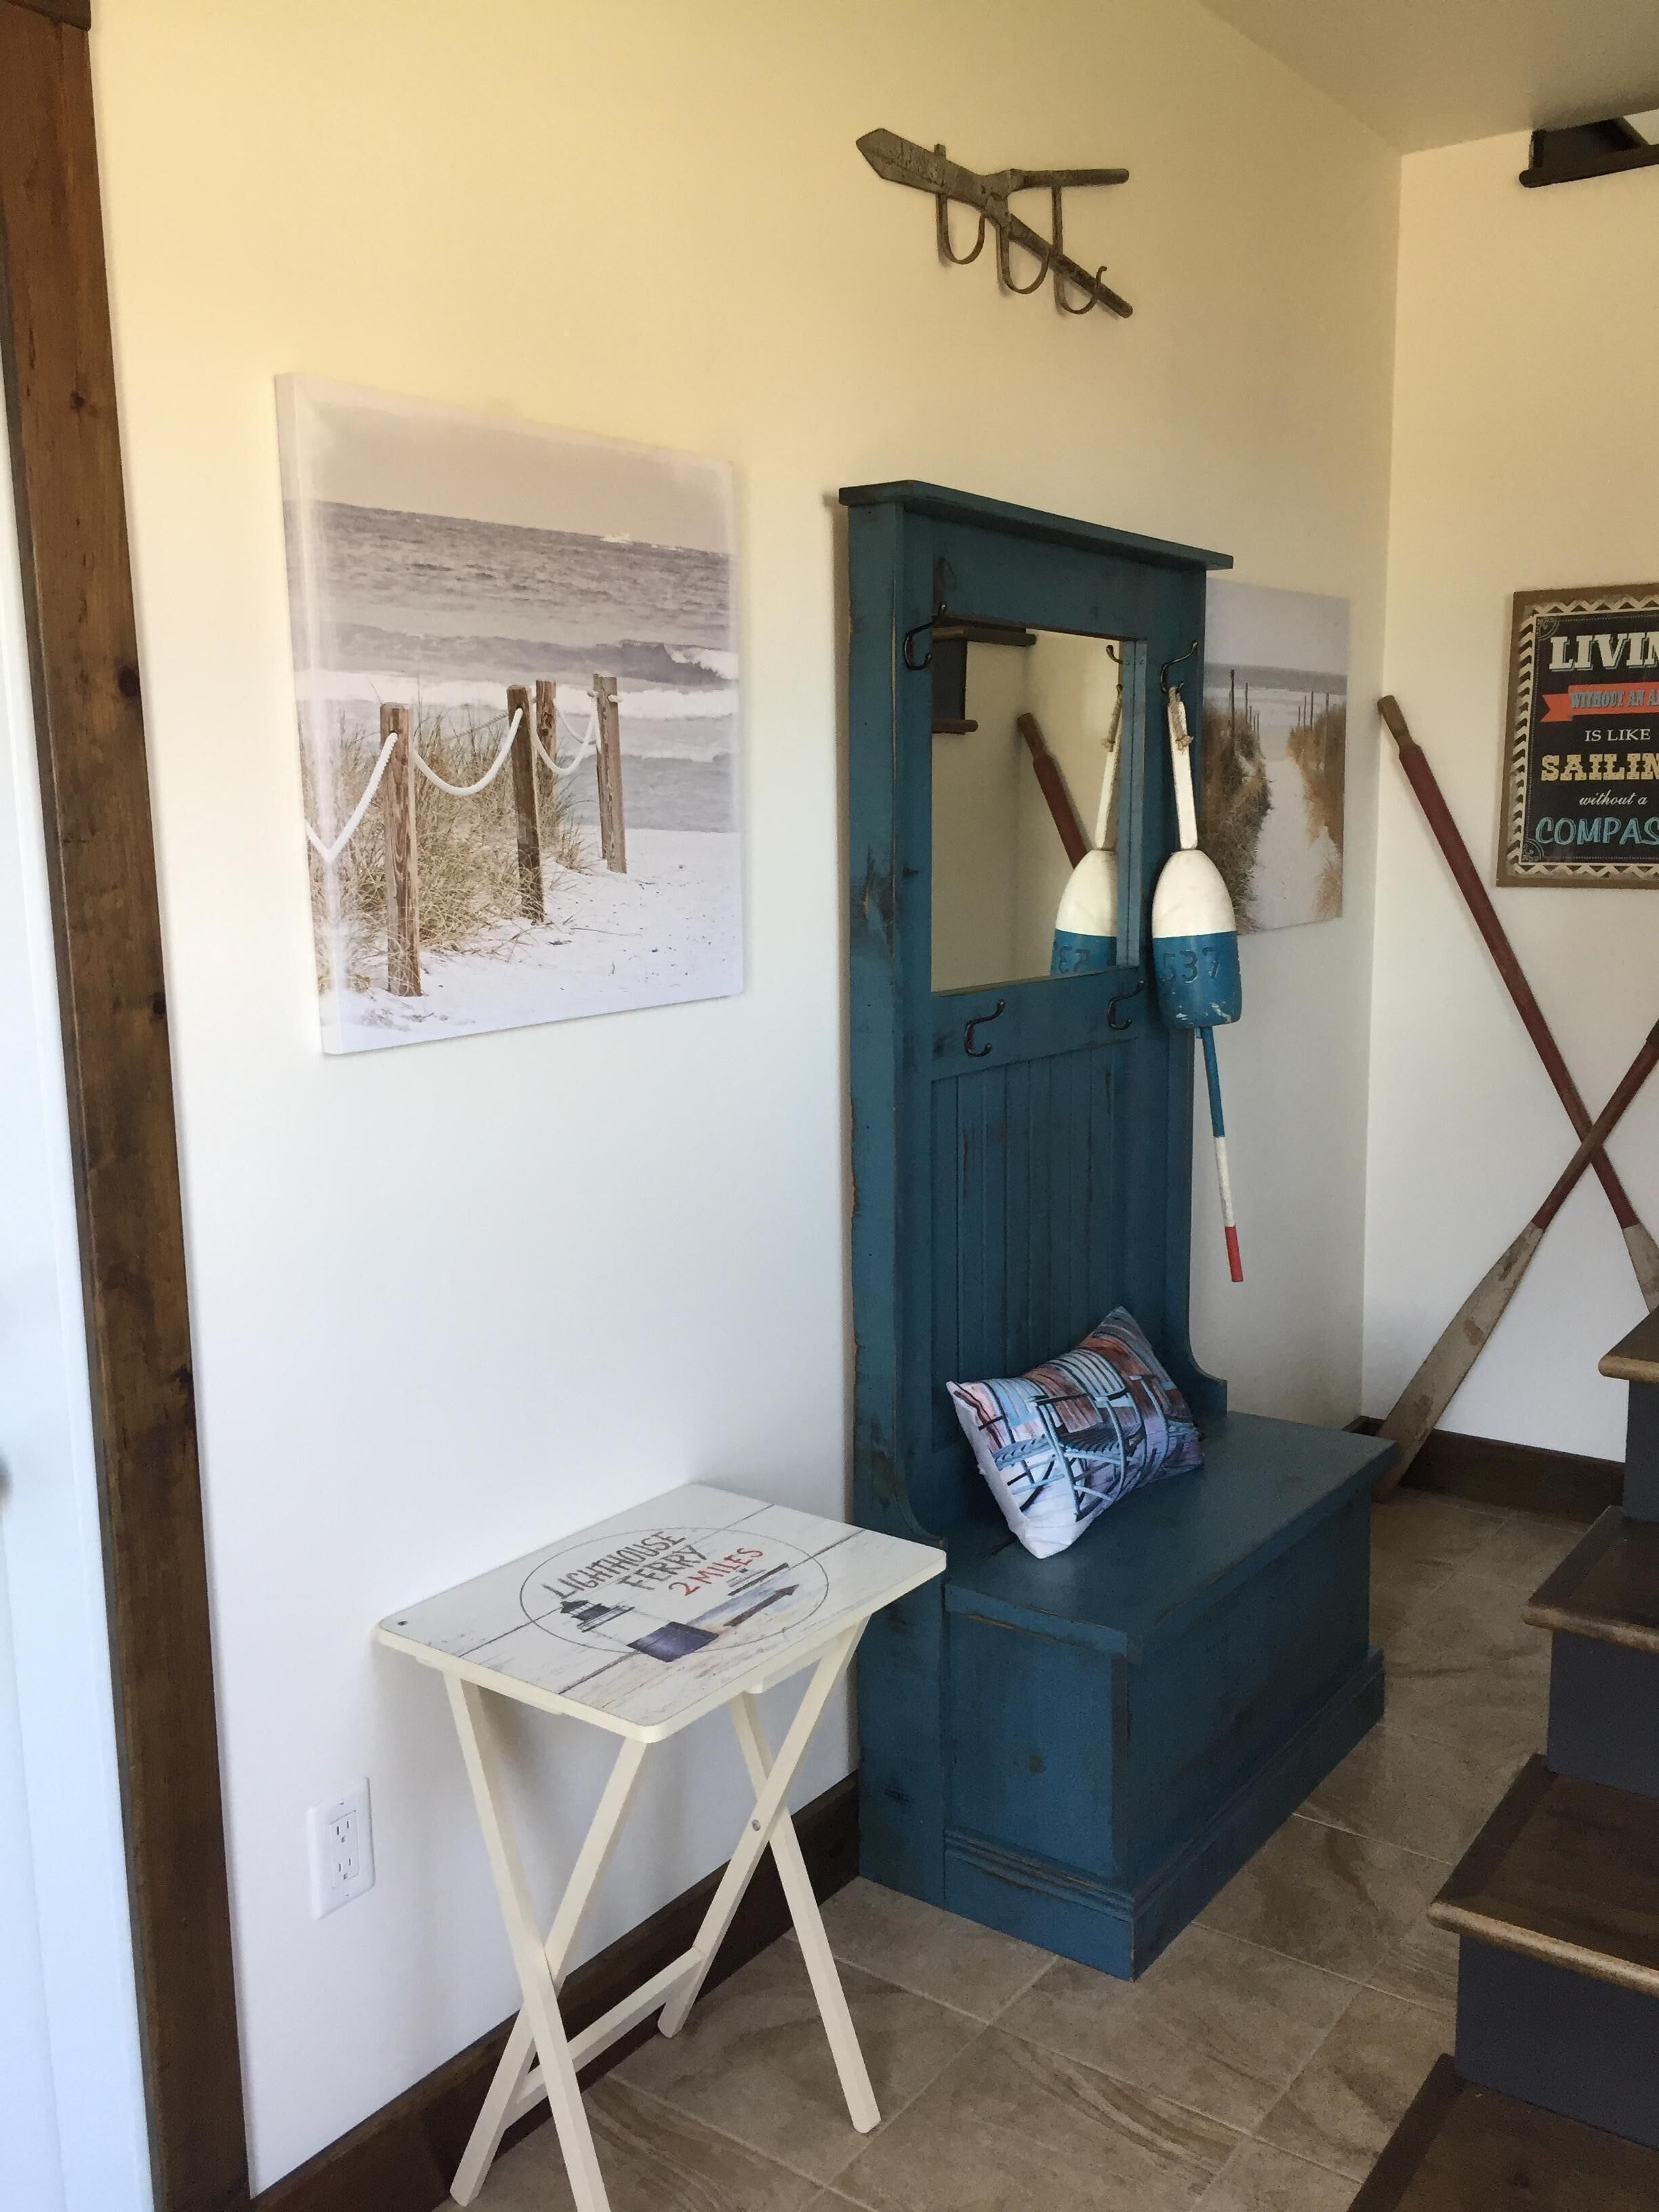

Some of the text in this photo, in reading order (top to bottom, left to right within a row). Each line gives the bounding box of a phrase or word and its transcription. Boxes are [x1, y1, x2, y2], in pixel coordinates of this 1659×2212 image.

[1571, 691, 1626, 708] WITHOUT
[1628, 689, 1645, 707] AN
[1584, 729, 1652, 742] IS LIKE
[1579, 789, 1647, 806] without a
[1160, 947, 1221, 983] 537
[541, 1530, 686, 1599] LIGHTHOUSE
[617, 1544, 708, 1591] FERRY
[668, 1547, 764, 1596] 2 MILES
